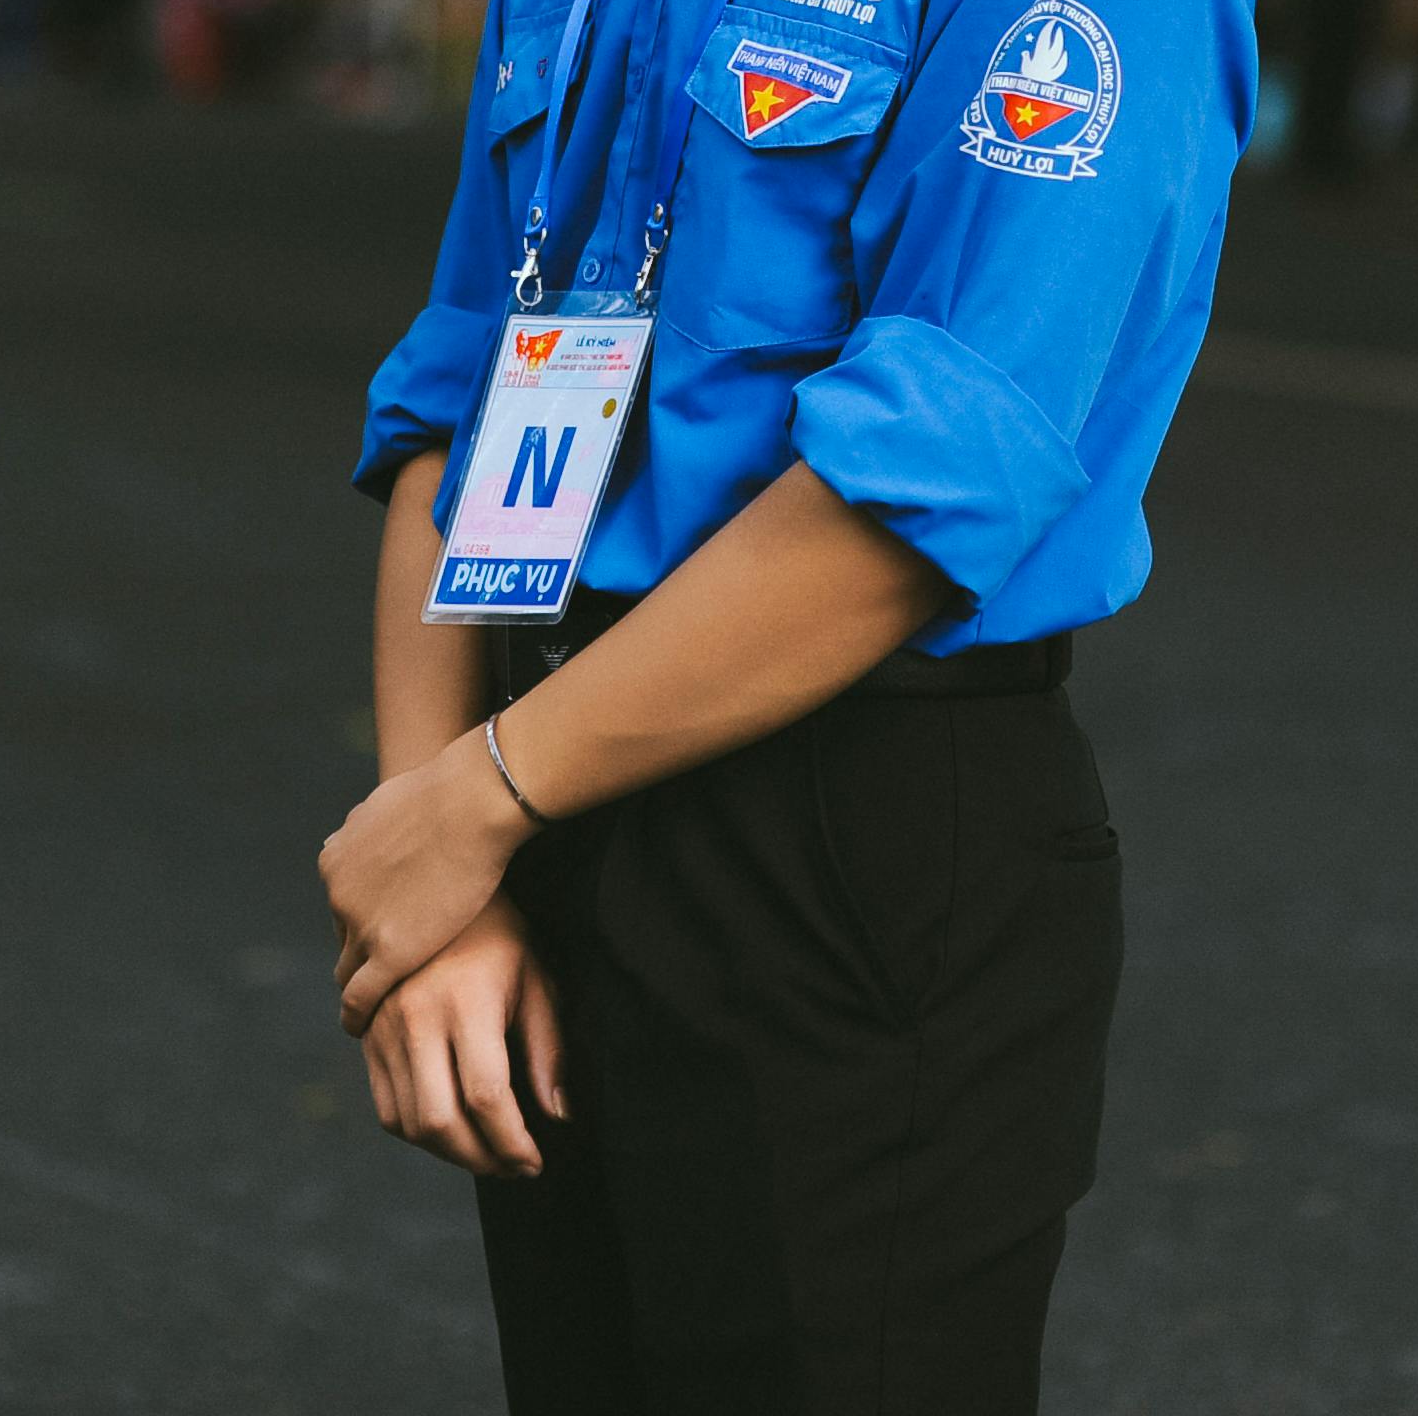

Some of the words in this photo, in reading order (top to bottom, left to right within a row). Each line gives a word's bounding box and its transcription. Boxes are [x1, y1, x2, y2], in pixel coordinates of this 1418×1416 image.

[852, 2, 876, 24] LỢI
[810, 70, 840, 92] NAM
[1101, 63, 1114, 90] HỌC
[1063, 91, 1089, 107] NAM
[1024, 155, 1054, 174] LỢI
[502, 426, 577, 508] N
[450, 563, 521, 601] PHỤC
[525, 564, 559, 602] VỤ
